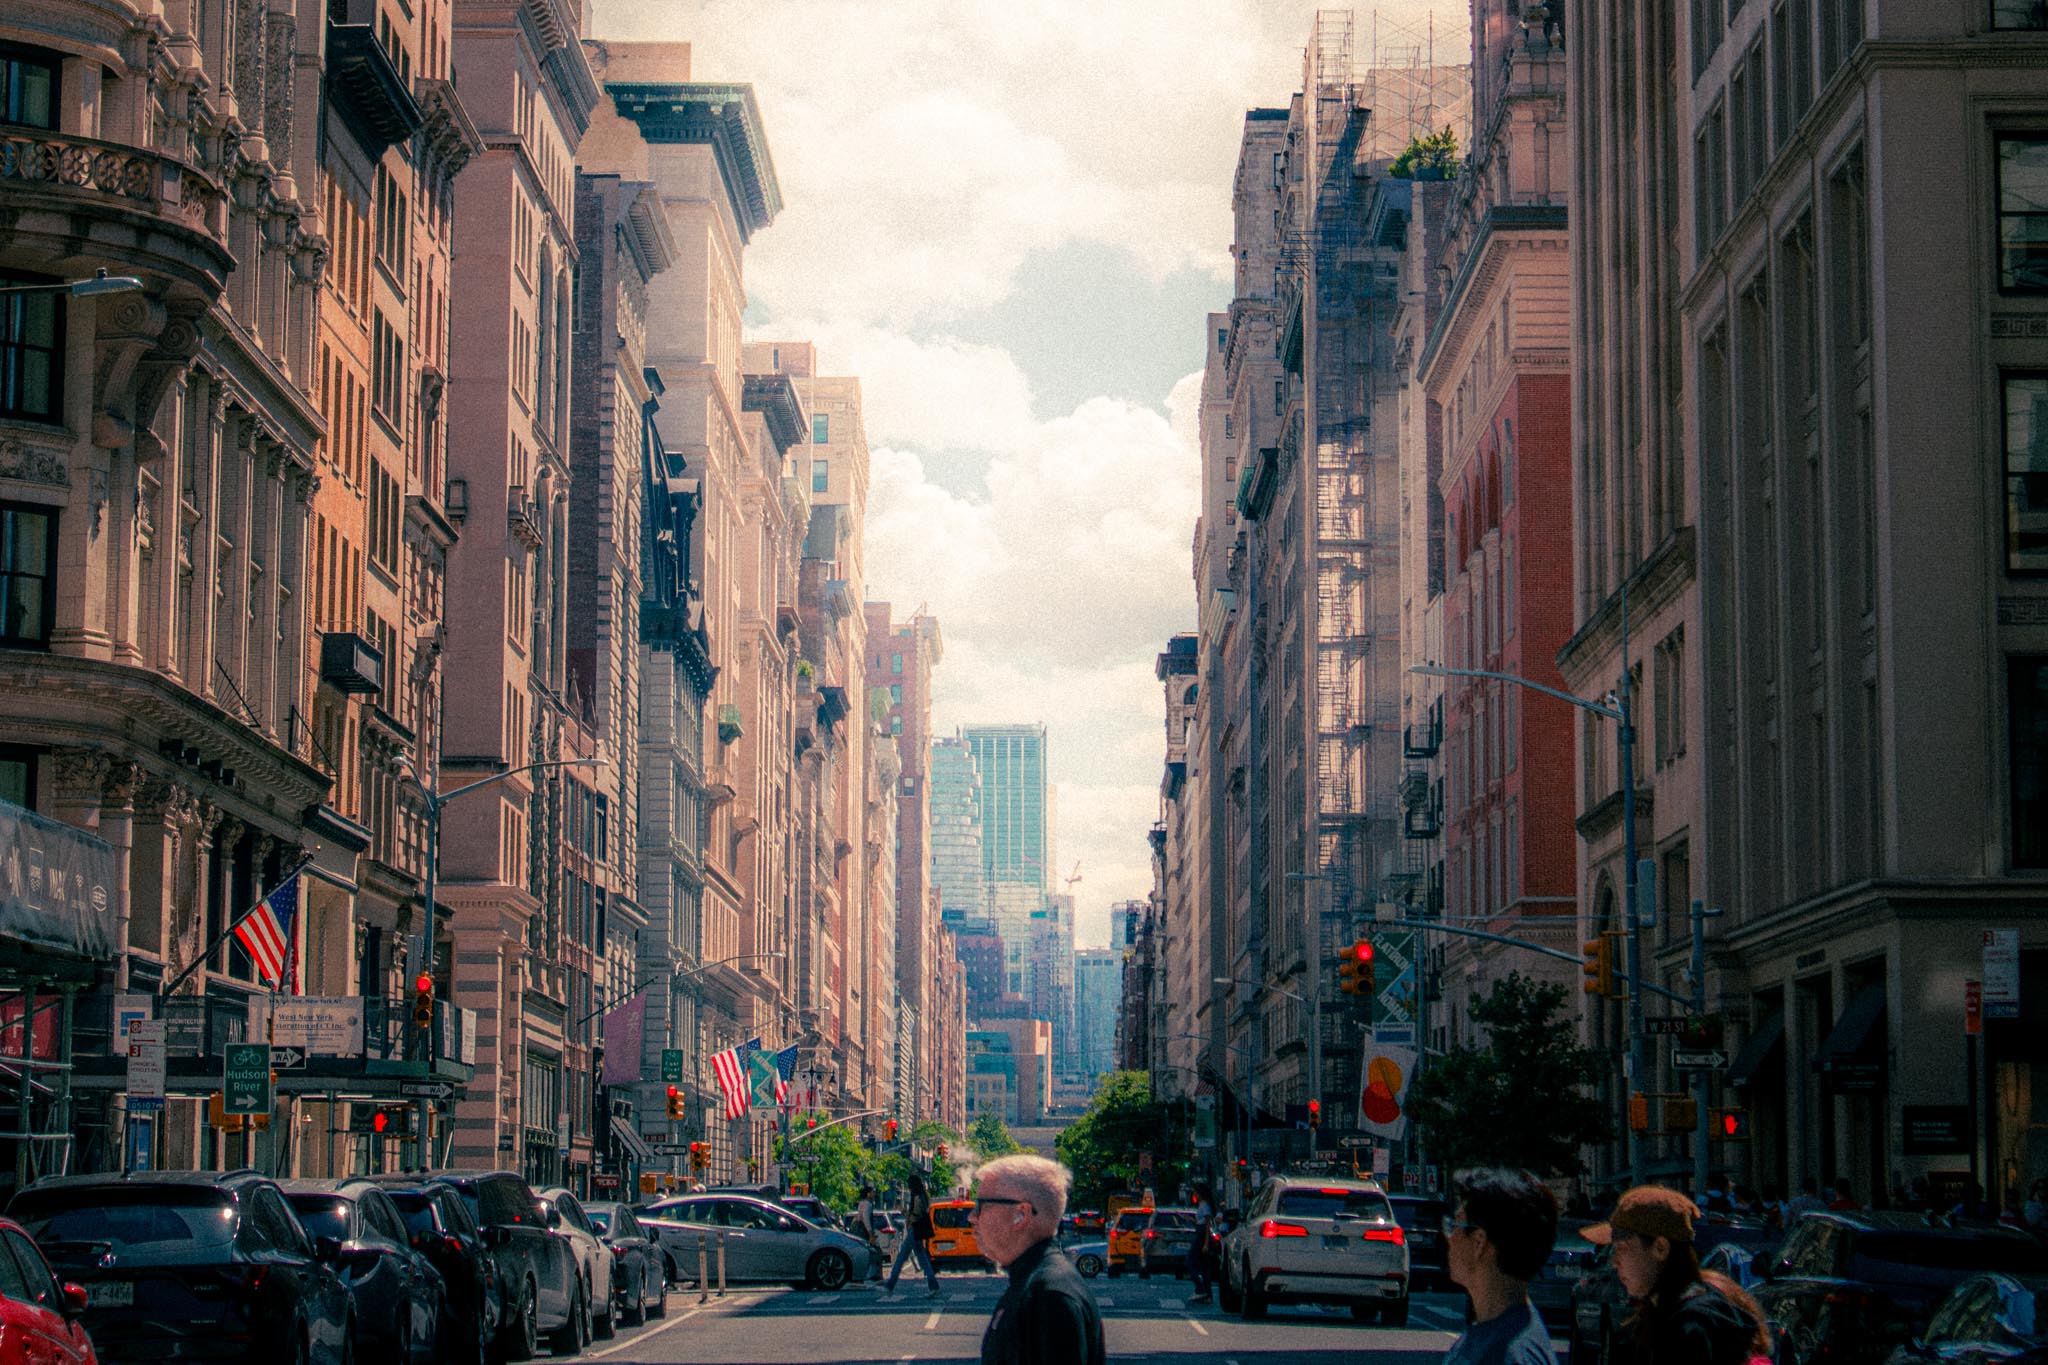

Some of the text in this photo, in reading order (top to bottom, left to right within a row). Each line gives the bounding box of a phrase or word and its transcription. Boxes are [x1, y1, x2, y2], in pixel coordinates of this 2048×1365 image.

[1372, 932, 1409, 970] FLATIRON
[1380, 992, 1409, 1022] NOMAD
[279, 1013, 334, 1021] West New York
[1650, 1022, 1658, 1033] W
[1662, 1021, 1672, 1032] 21
[0, 1047, 17, 1056] VE,
[275, 1053, 296, 1062] WAY
[227, 1070, 268, 1080] Hudson
[234, 1081, 261, 1092] River
[430, 1086, 448, 1095] WAY
[1404, 1174, 1436, 1185] PIZA
